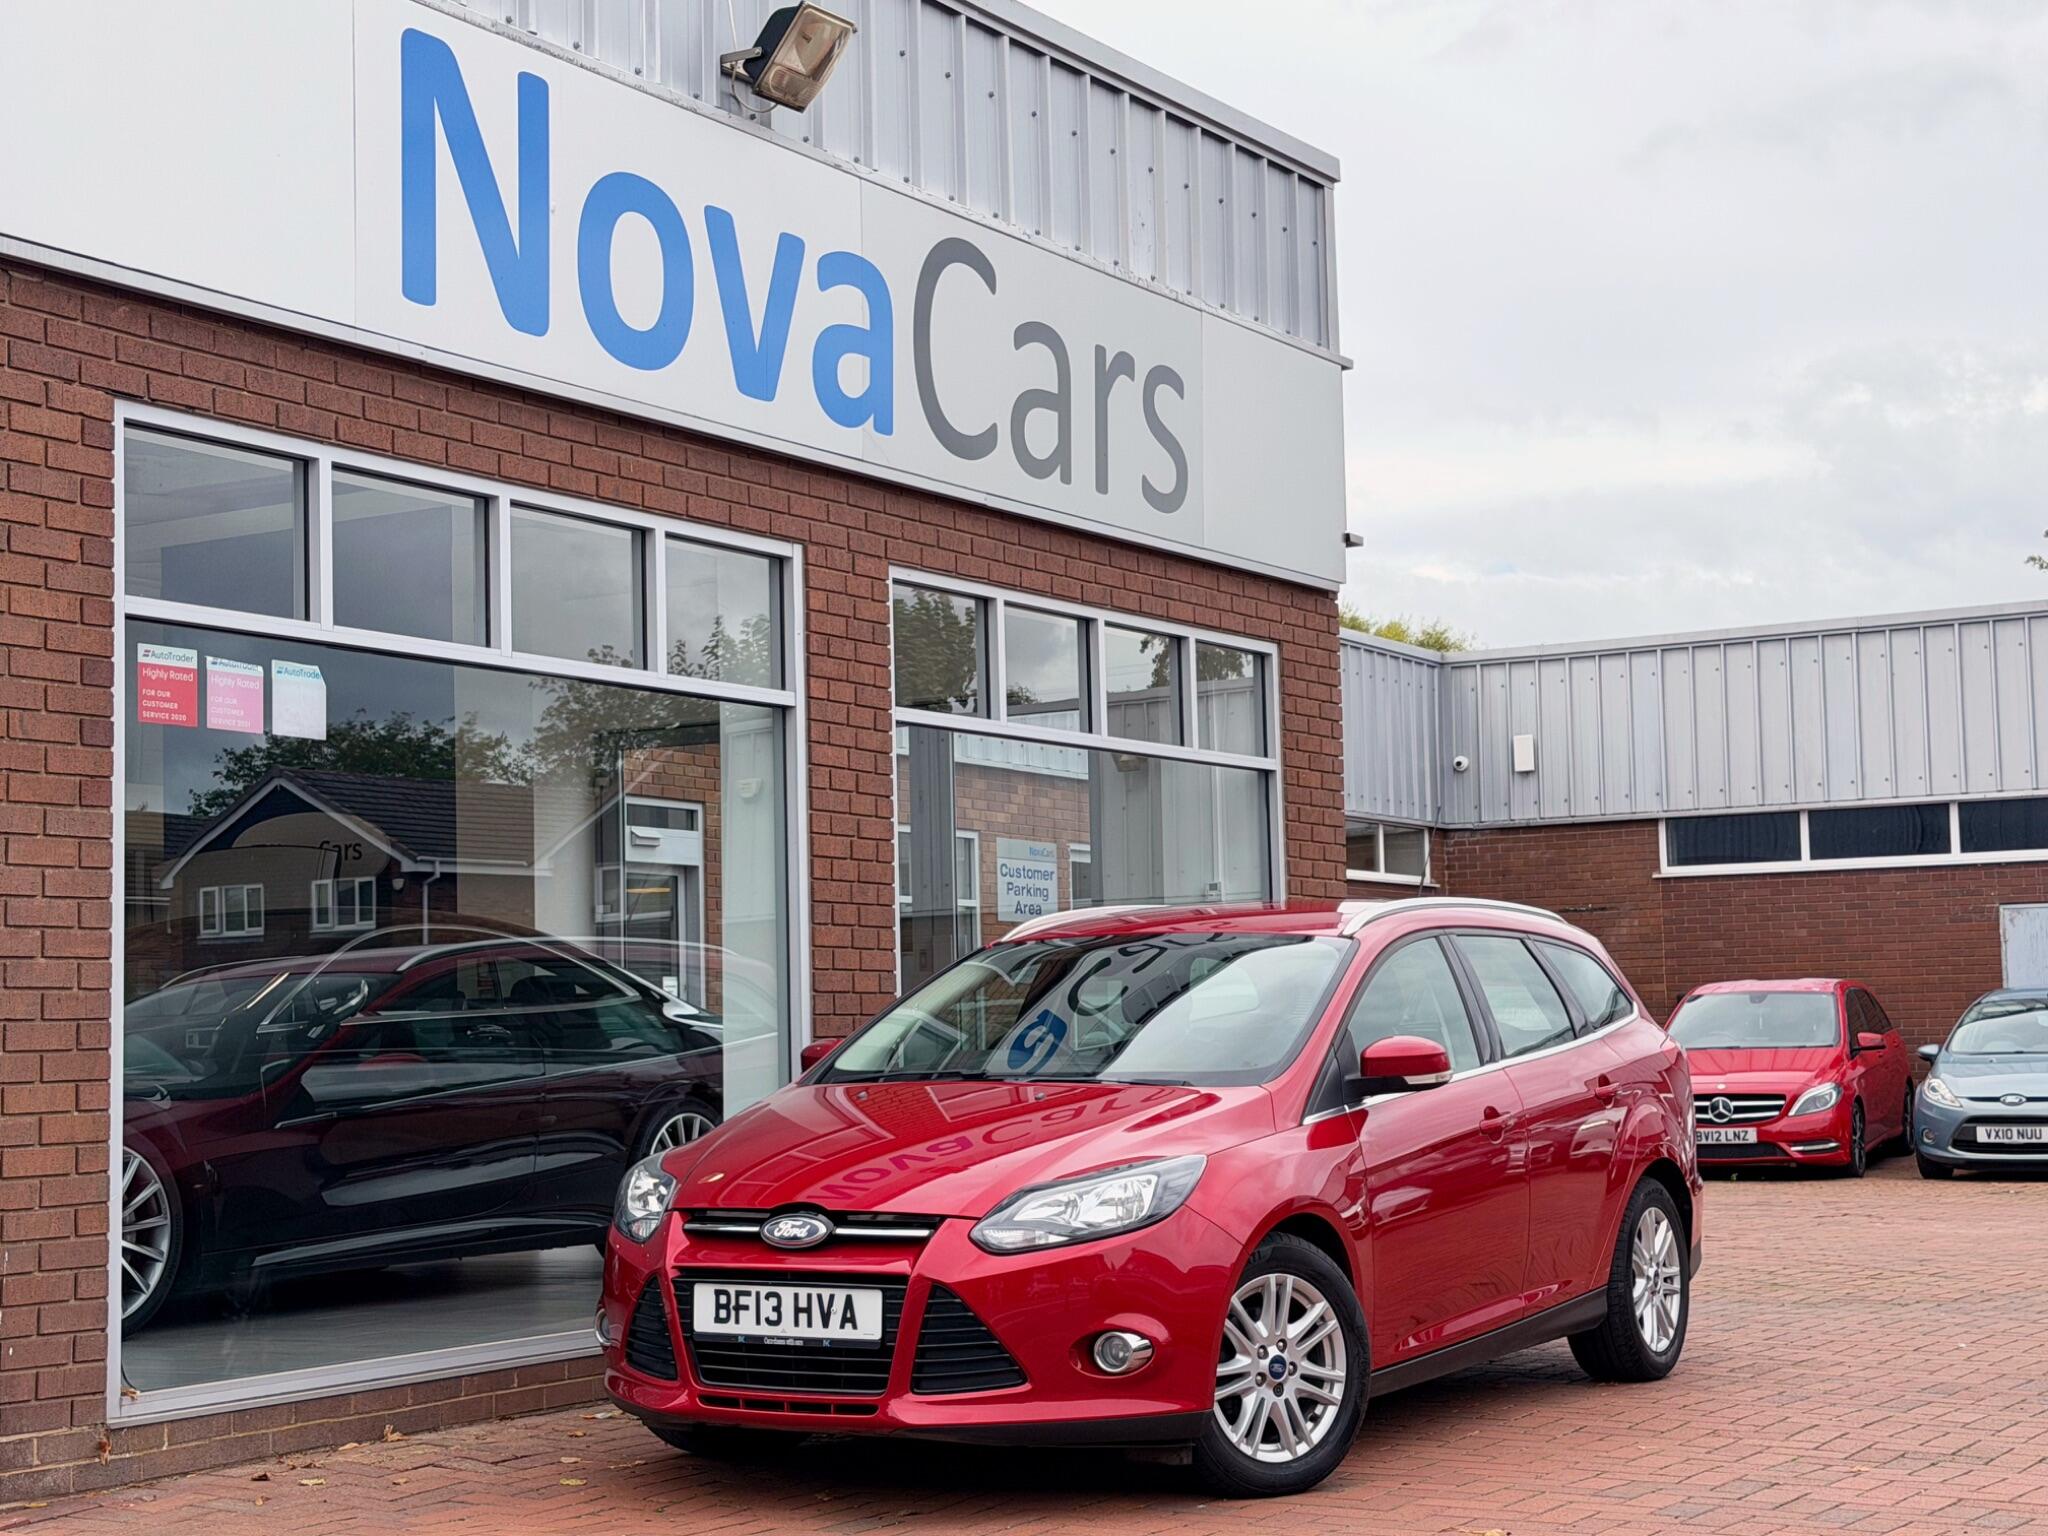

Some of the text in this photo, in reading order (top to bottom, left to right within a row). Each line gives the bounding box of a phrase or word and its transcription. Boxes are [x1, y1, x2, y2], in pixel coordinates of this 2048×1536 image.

[402, 28, 1188, 514] NovaCars
[150, 650, 194, 663] AutoTrader
[142, 667, 194, 682] Highly Rated
[284, 667, 321, 680] AutoTrade
[236, 679, 260, 690] Rated
[142, 688, 171, 698] FOR OUR
[142, 700, 178, 709] CUSTOMER
[142, 711, 187, 721] SERVICE 2020
[1000, 863, 1055, 881] Customer
[1006, 881, 1049, 902] Parking
[1014, 900, 1042, 915] Area
[1696, 1130, 1749, 1142] BV12 LNZ
[1985, 1128, 2042, 1140] VX10 NUU
[773, 1219, 811, 1239] Ford
[713, 1288, 858, 1330] BF13 HVA
